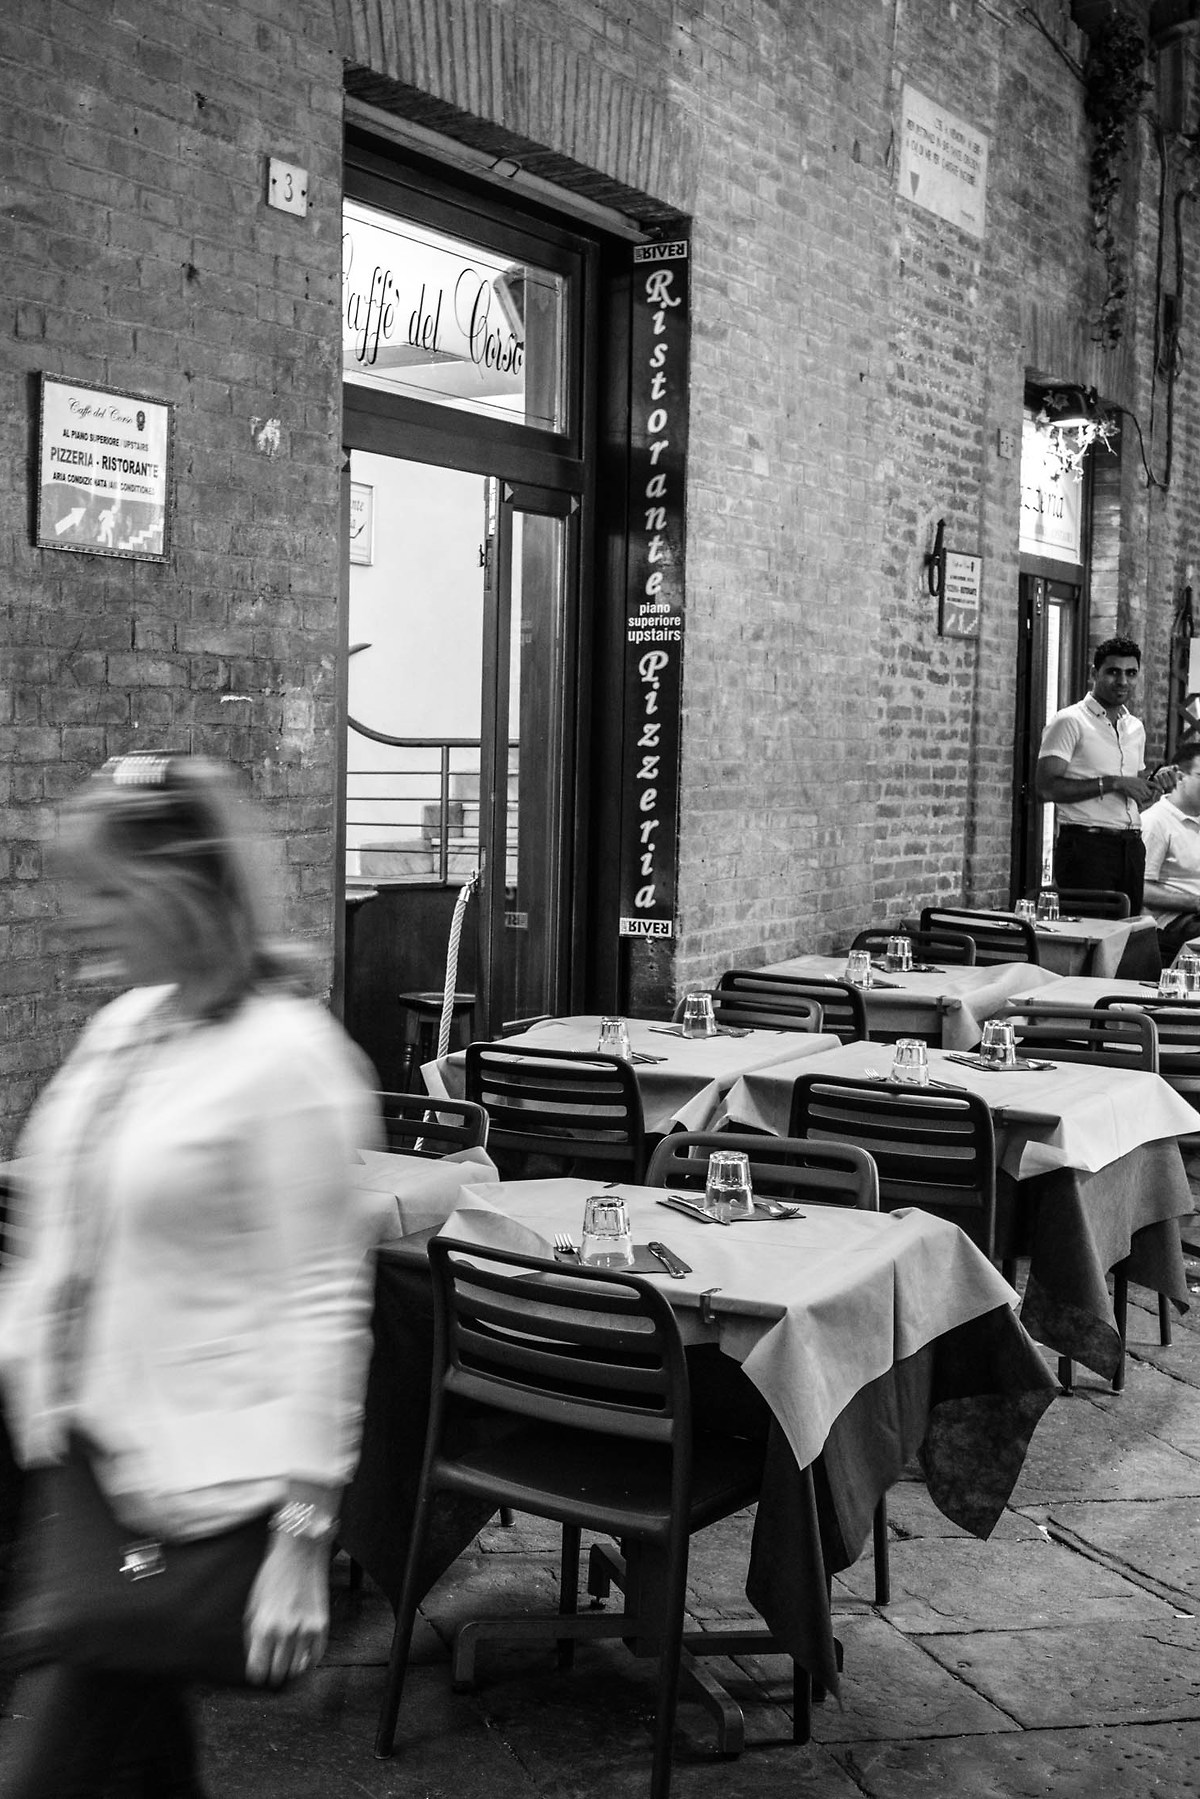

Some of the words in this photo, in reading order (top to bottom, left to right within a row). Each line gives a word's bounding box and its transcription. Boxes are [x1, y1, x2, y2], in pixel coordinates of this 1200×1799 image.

[284, 172, 294, 203] 3
[408, 283, 444, 354] del
[454, 268, 525, 380] Corso
[93, 407, 108, 419] del
[62, 428, 70, 438] AL
[71, 430, 88, 441] PIANO
[89, 433, 119, 447] SUPERIORE
[645, 269, 681, 596] Ristorante
[50, 446, 94, 467] PIZZERIA
[101, 455, 159, 479] RISTORANTE
[52, 472, 66, 482] ARIA
[639, 603, 671, 616] piano
[628, 614, 681, 628] superiore
[628, 627, 681, 642] upstairs
[636, 650, 669, 909] Pizzeria
